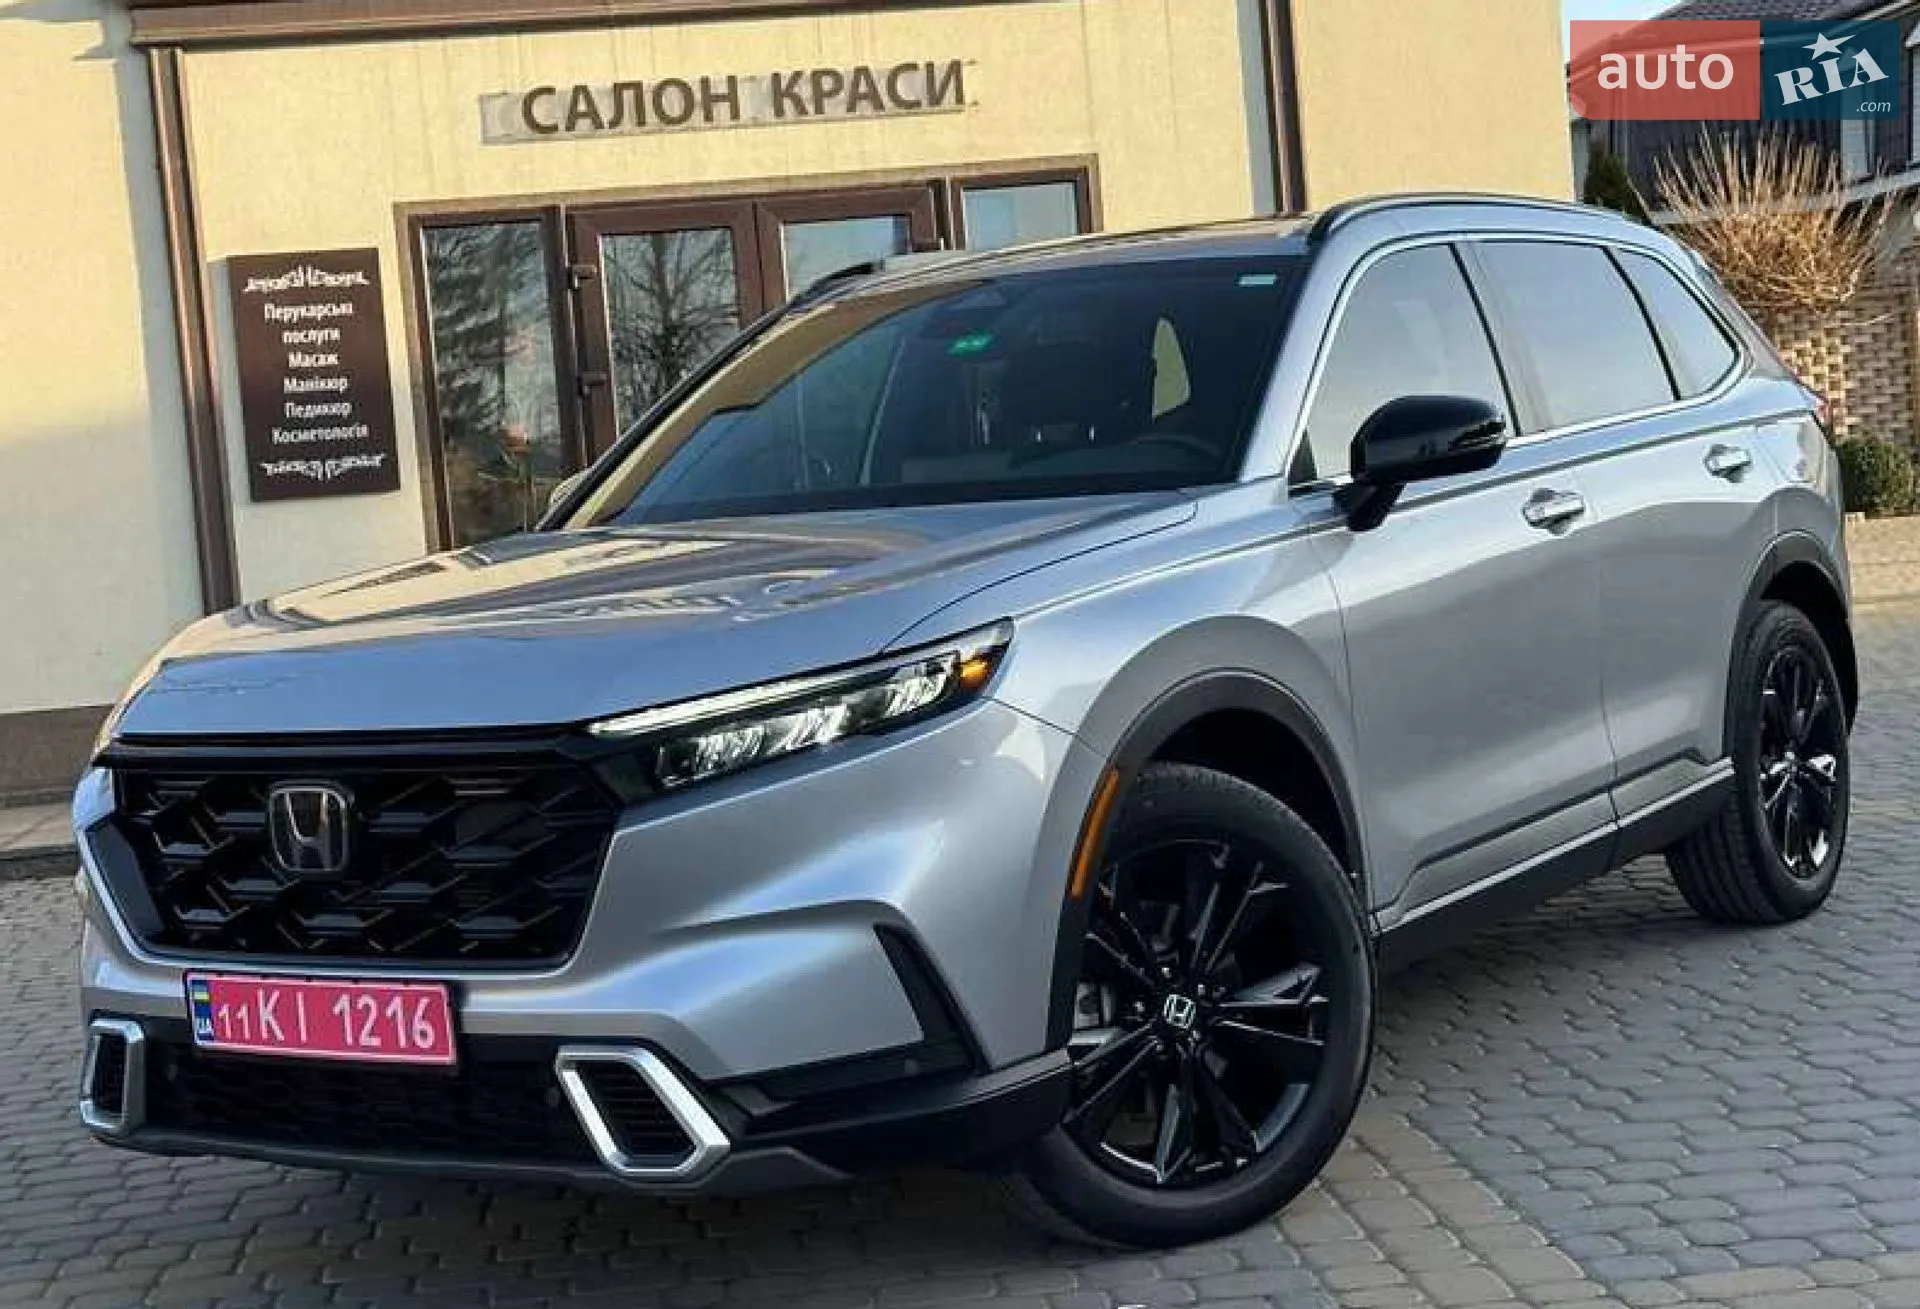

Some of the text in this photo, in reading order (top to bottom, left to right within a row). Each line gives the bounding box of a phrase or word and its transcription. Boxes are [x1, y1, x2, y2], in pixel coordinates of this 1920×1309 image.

[521, 59, 967, 135] САЛОН КРАСИ
[288, 352, 339, 368] Масаж
[333, 993, 435, 1049] 1216
